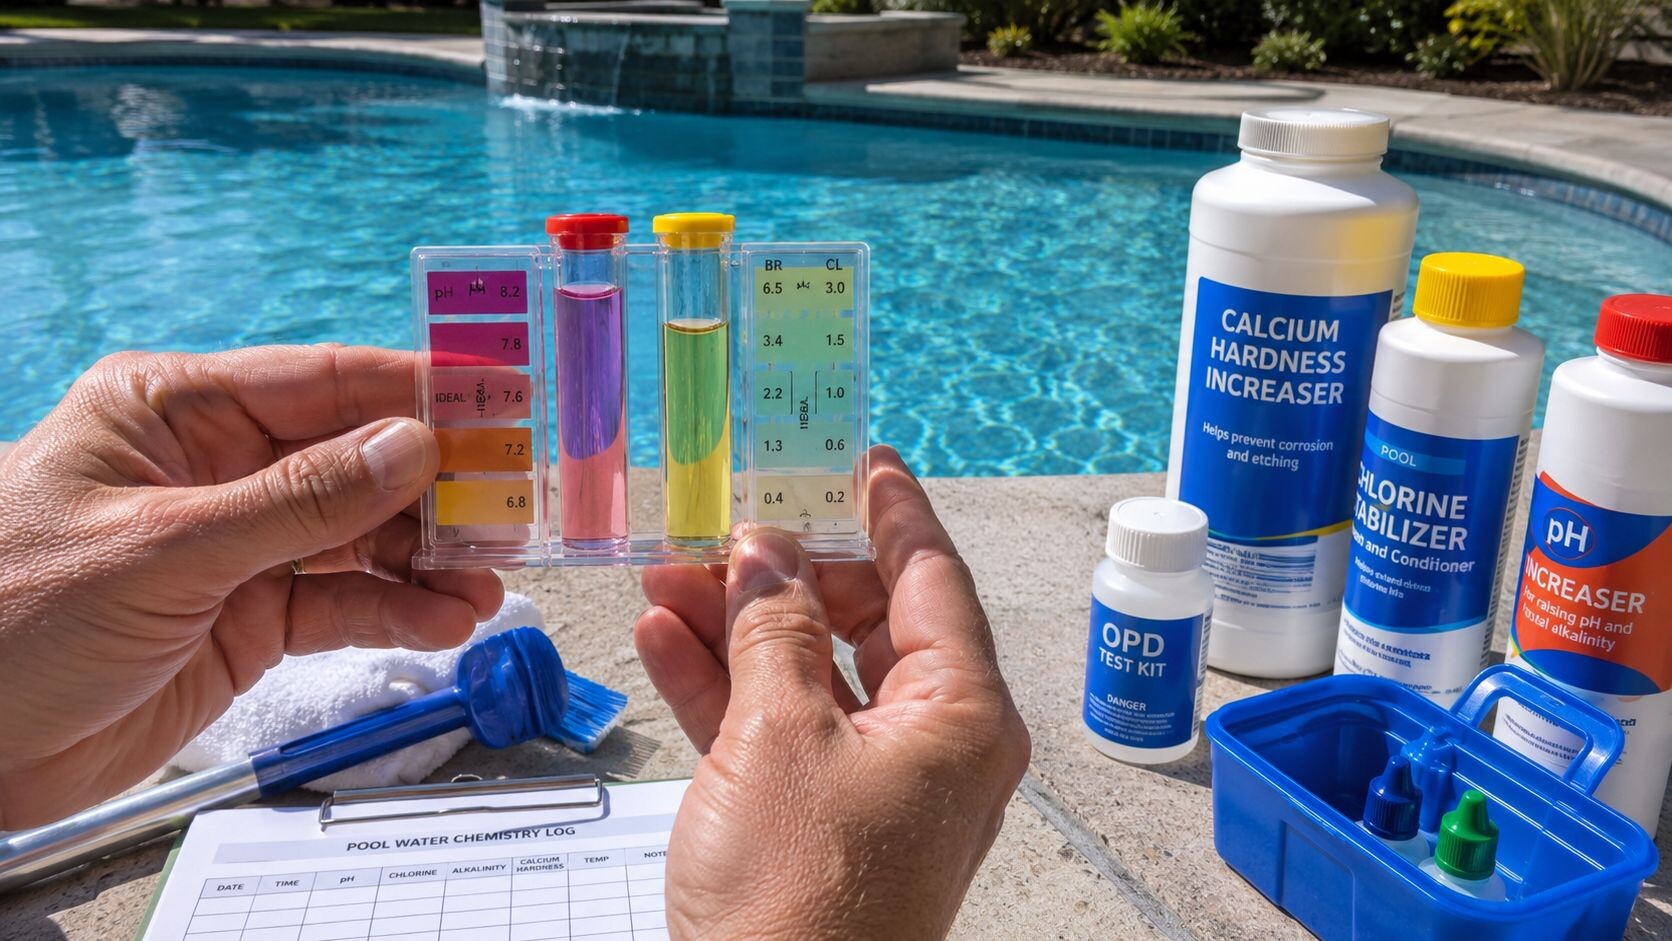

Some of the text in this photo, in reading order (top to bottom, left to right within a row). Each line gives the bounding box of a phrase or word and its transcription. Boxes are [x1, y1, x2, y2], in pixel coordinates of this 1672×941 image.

[765, 260, 782, 271] BR
[826, 259, 843, 270] CL
[435, 286, 453, 301] pH
[500, 286, 520, 298] 8.2
[763, 282, 783, 294] 6.5
[826, 281, 845, 294] 3.0
[1221, 308, 1340, 343] CALCIUM
[501, 338, 521, 350] 7.8
[763, 335, 783, 347] 3.4
[826, 334, 845, 346] 1.5
[1210, 336, 1346, 374] HARDNESS
[1205, 366, 1344, 405] INCREASER
[435, 392, 466, 403] IDEAL
[503, 391, 523, 403] 7.6
[763, 388, 783, 400] 2.2
[826, 387, 845, 399] 1.0
[1202, 421, 1333, 452] Helps prevent corrosion
[504, 443, 525, 456] 7.2
[764, 439, 783, 452] 1.3
[825, 439, 845, 451] 0.6
[1226, 448, 1300, 472] and etching
[1380, 444, 1417, 467] POOL
[506, 496, 526, 508] 6.8
[764, 492, 783, 504] 0.4
[825, 491, 845, 503] 0.2
[1355, 492, 1468, 551] TABILIZER
[1546, 517, 1589, 553] pH
[1365, 540, 1388, 559] and
[1525, 555, 1646, 614] INCREASER
[1536, 597, 1576, 625] raising
[1579, 615, 1601, 630] pH
[1604, 622, 1633, 635] and
[1102, 622, 1165, 658] OPD
[1551, 623, 1616, 652] alkalinity
[1099, 646, 1166, 678] TEST KIT
[1107, 693, 1146, 712] DANGER
[347, 826, 576, 851] POOL WATER CHEMISTRY LOG
[520, 856, 560, 865] CALCIUM
[584, 855, 609, 864] TEMP
[389, 869, 437, 879] CHLORINE
[452, 864, 506, 874] ALKALINITY
[516, 863, 564, 873] HARDNESS
[275, 879, 300, 888] TIME
[340, 876, 355, 885] pH
[217, 883, 244, 892] DATE
